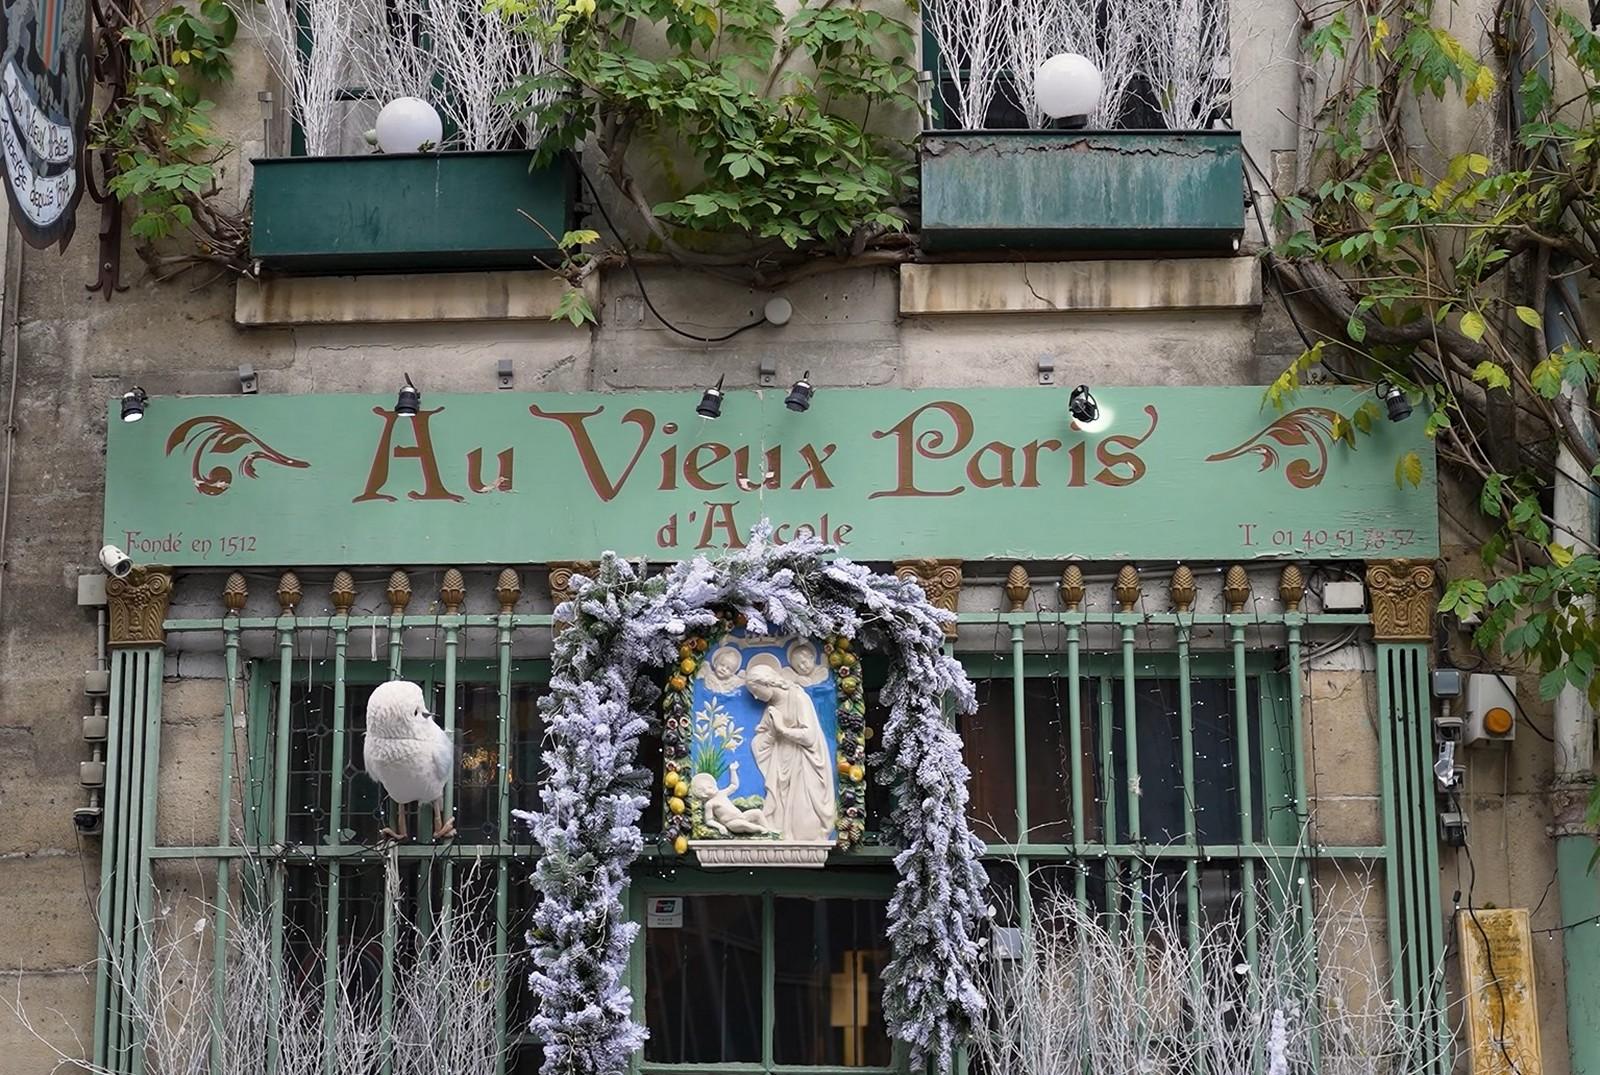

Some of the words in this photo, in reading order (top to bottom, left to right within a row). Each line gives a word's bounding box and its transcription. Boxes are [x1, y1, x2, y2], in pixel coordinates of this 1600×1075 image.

[352, 406, 514, 503] Au
[528, 404, 836, 503] Vieux
[870, 401, 1159, 498] Paris
[121, 530, 183, 560] Fondé
[191, 538, 213, 560] en
[219, 535, 257, 557] 1512
[656, 500, 854, 550] d'Acole
[1238, 524, 1259, 546] T.
[1272, 530, 1293, 546] 01
[1302, 530, 1328, 549] 40
[1335, 530, 1354, 548] 51
[1391, 529, 1415, 550] 52
